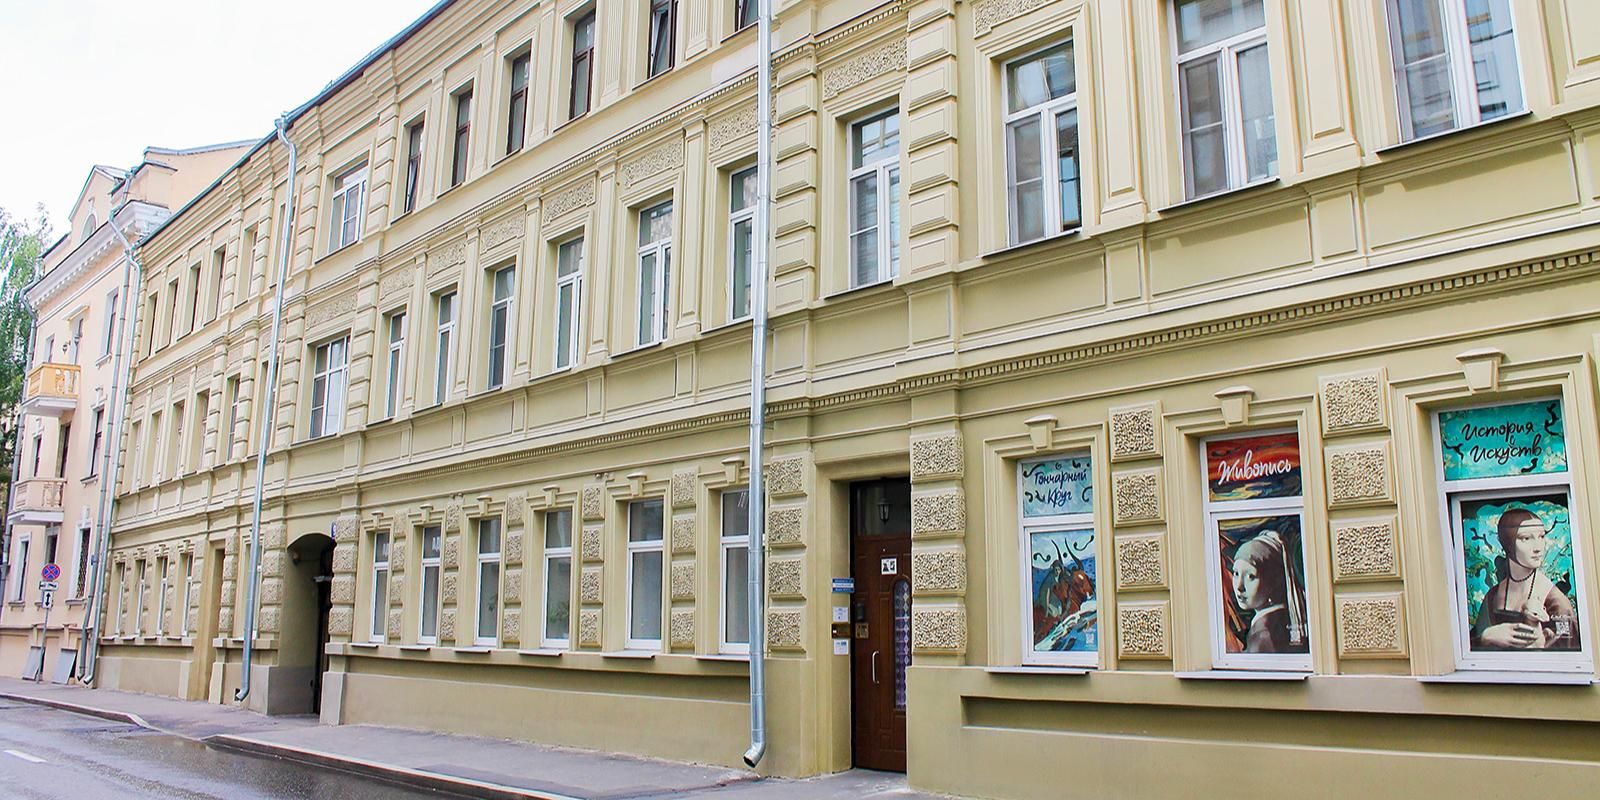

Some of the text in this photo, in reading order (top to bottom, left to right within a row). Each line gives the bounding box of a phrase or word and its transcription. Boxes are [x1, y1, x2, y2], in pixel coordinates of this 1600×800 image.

[1461, 421, 1534, 442] История
[1217, 449, 1292, 485] Живопись
[1034, 469, 1087, 489] Гончарный
[1047, 488, 1073, 508] Круг
